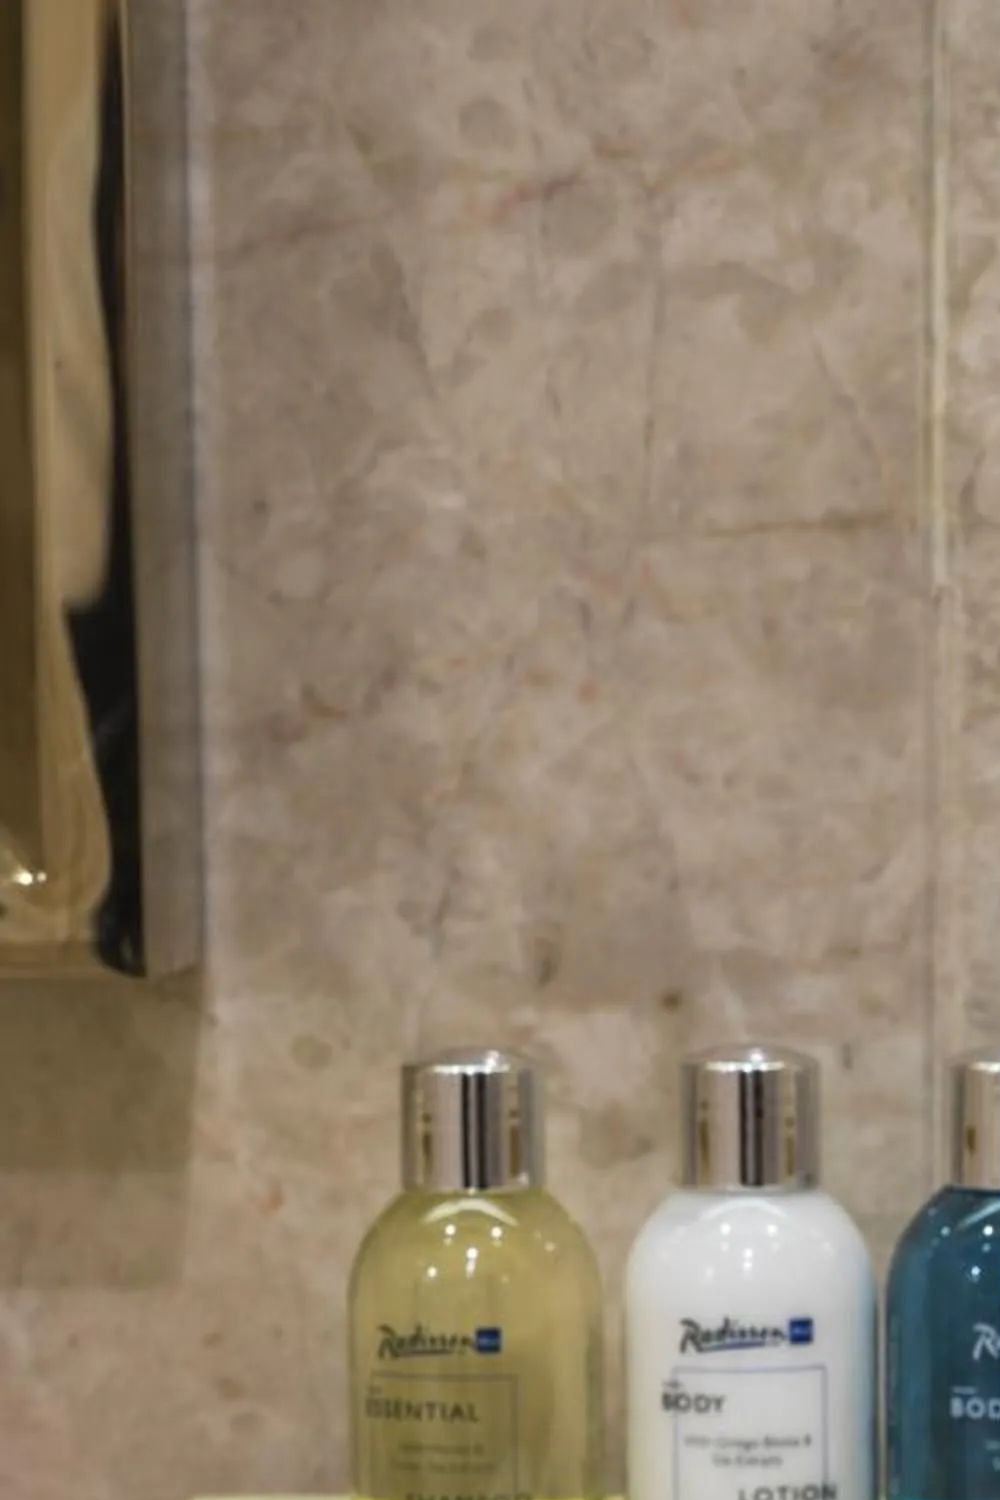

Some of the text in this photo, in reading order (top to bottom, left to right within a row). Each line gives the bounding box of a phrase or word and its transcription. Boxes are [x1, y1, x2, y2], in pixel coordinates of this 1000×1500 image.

[377, 1322, 475, 1361] Radisson
[679, 1316, 786, 1355] Radisson
[661, 1391, 726, 1414] BODY
